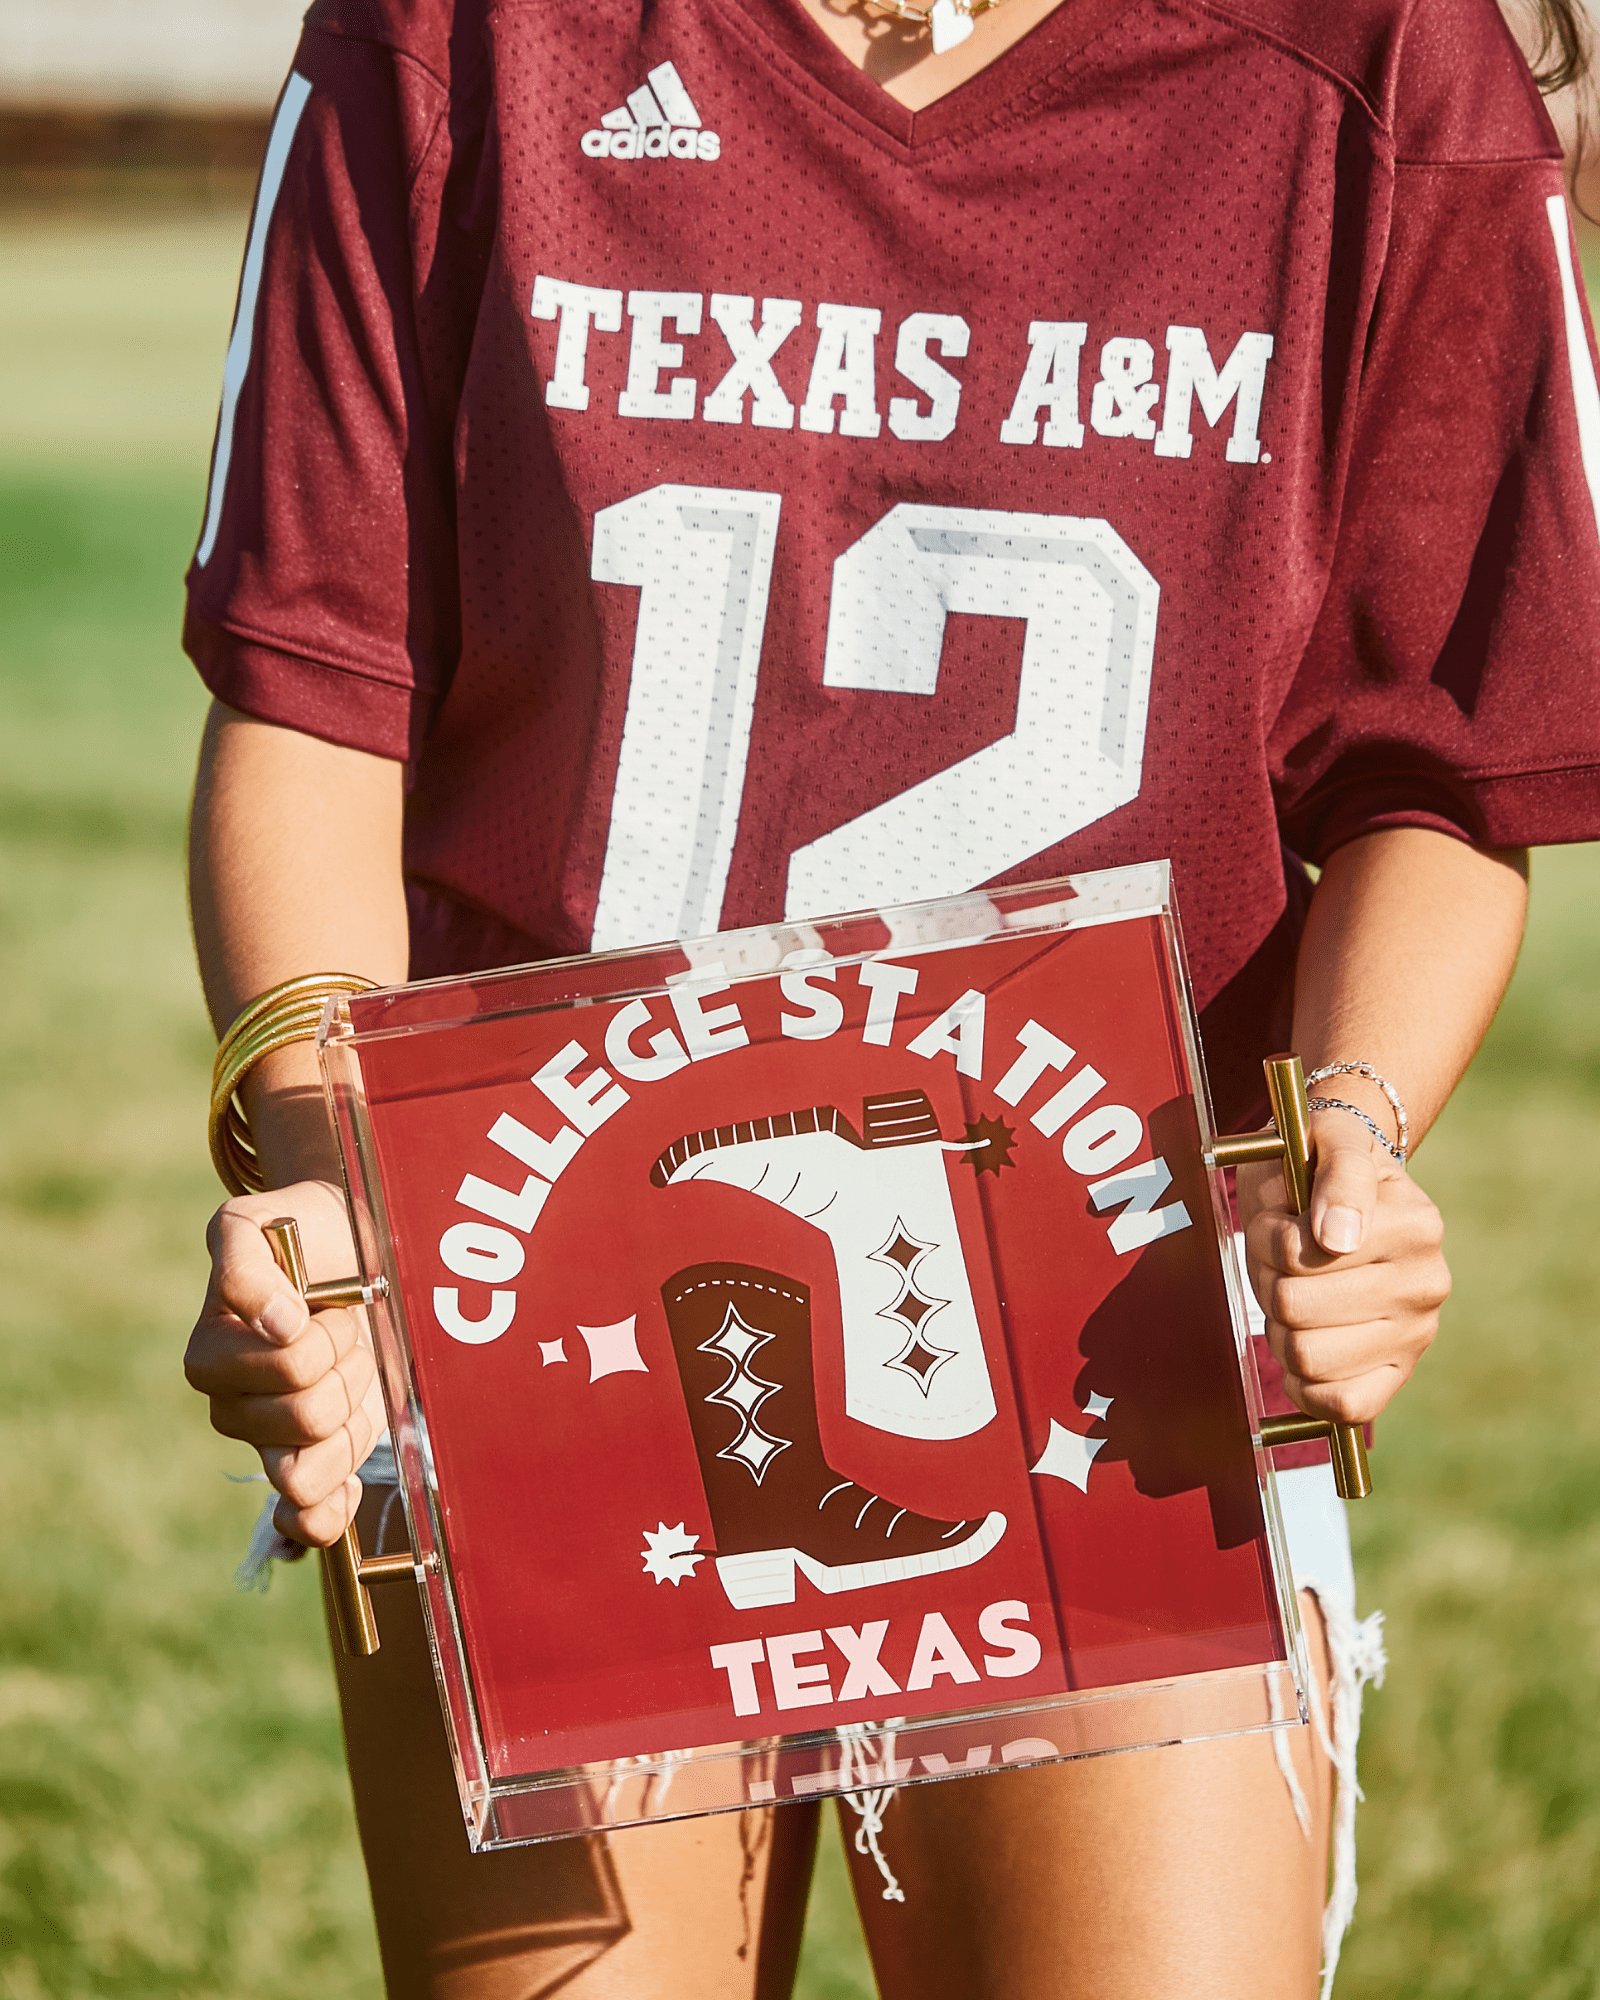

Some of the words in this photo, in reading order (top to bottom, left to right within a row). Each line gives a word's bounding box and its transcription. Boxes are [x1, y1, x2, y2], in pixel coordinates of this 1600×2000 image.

[580, 120, 721, 161] adidas
[530, 275, 971, 442] TEXAS
[590, 482, 1162, 954] 12
[432, 960, 751, 1345] COLLEGE
[779, 948, 1195, 1256] STATION
[709, 1599, 1043, 1718] TEXAS
